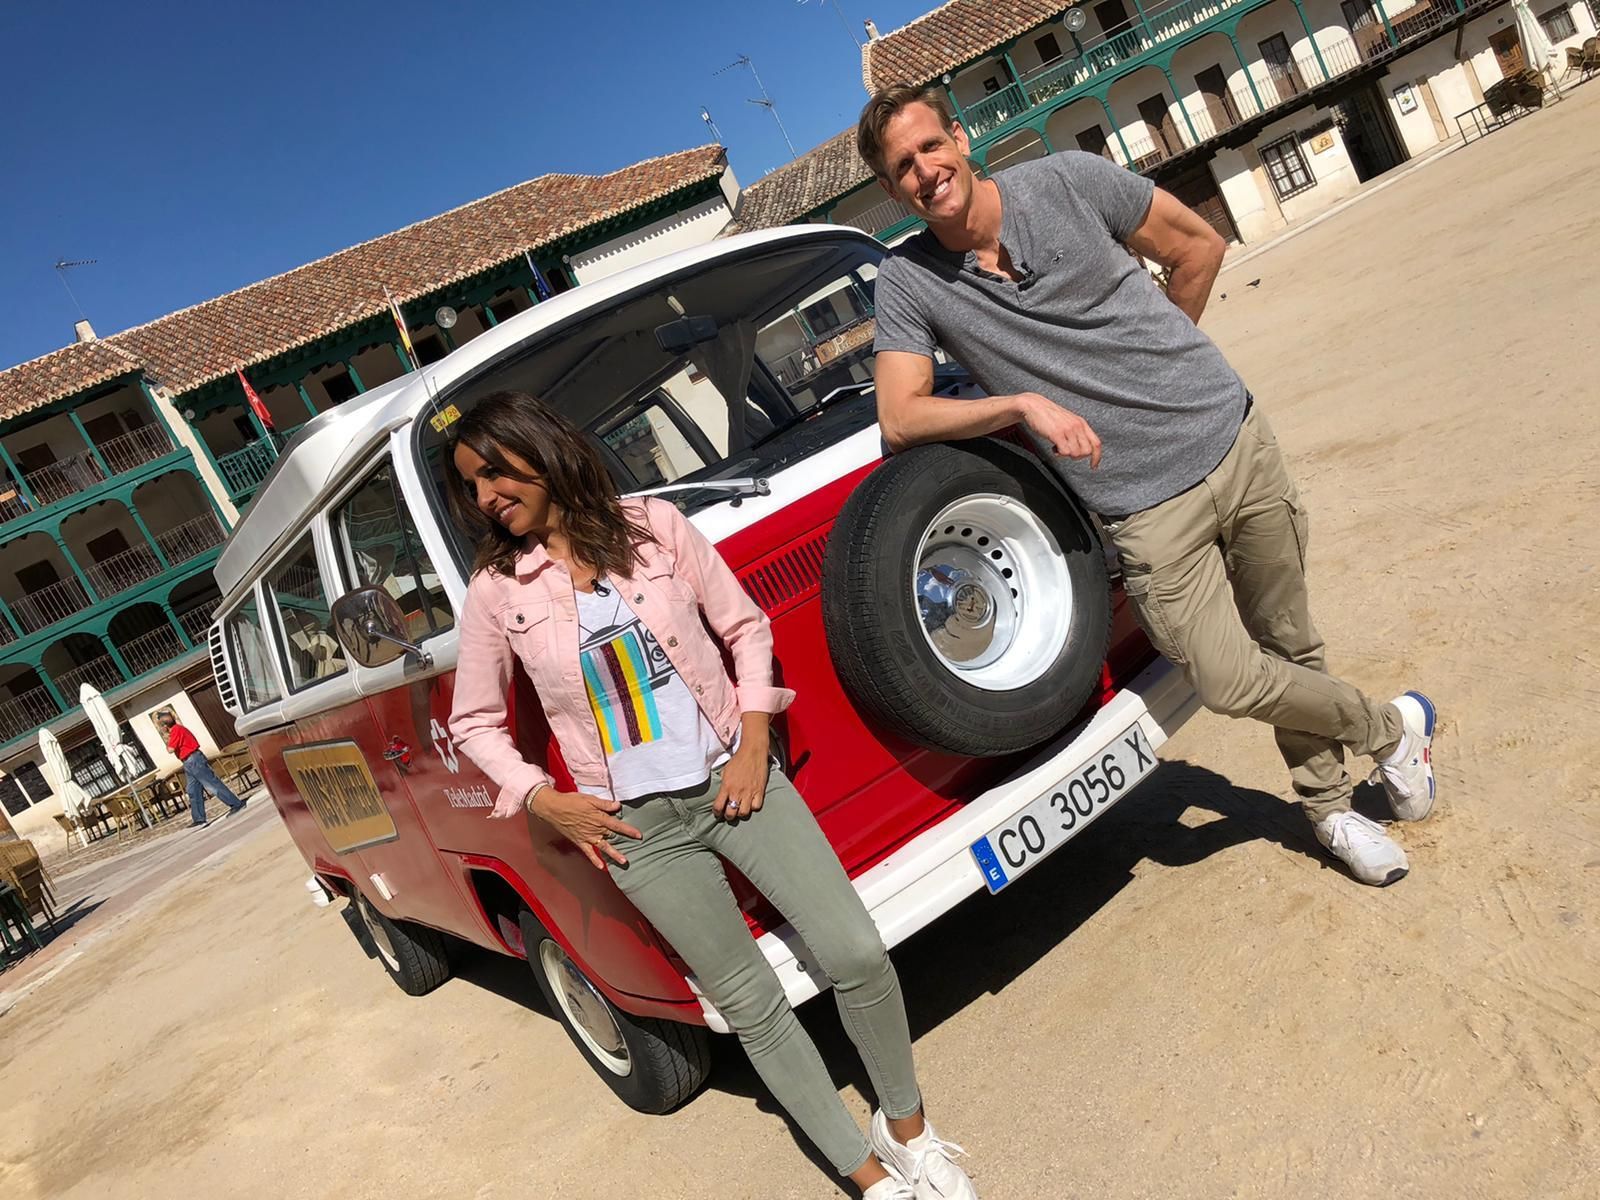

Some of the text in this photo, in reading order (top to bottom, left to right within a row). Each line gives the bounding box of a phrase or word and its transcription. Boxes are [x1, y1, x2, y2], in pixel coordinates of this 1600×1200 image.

[998, 731, 1152, 868] CO 3056 X
[989, 867, 1000, 881] E
